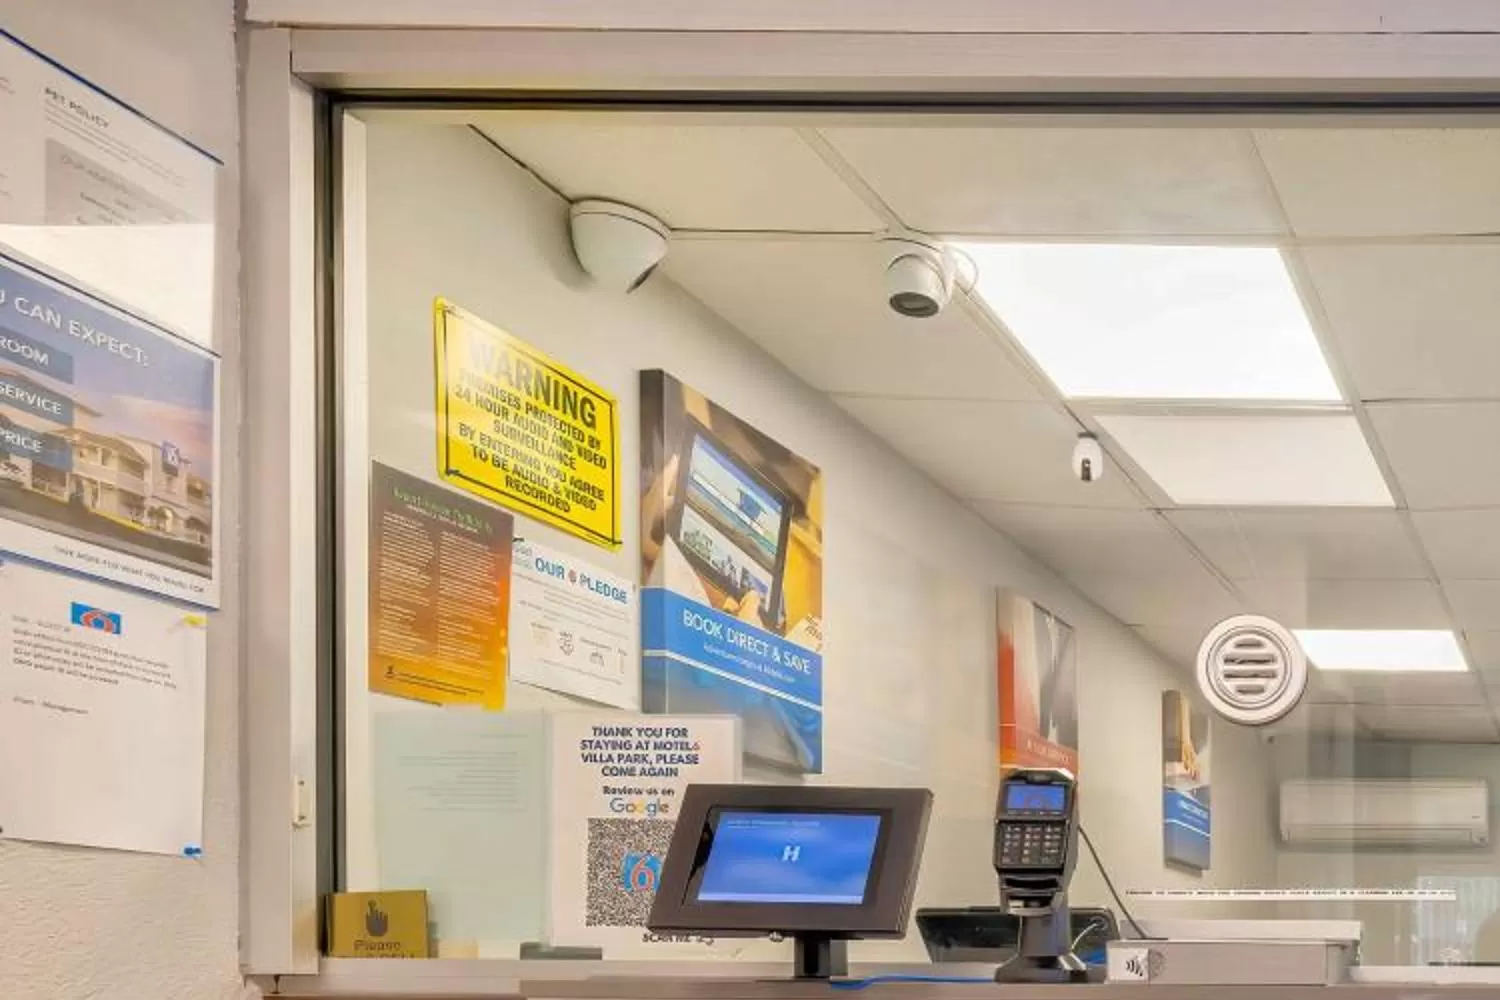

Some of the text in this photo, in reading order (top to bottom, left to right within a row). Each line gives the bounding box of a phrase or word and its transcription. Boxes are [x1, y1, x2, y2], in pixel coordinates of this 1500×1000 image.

[14, 297, 62, 329] CAN
[469, 340, 597, 430] WARNING
[475, 392, 509, 421] HOUR
[512, 412, 549, 441] AUDIO
[575, 443, 607, 470] VIDEO
[525, 402, 585, 443] PROTECTED
[458, 422, 605, 502] BY ENTERING YOU AGREE
[493, 419, 578, 471] SURVEILLANCE
[471, 443, 597, 511] TO BE AUDIO & VIDEO
[505, 474, 571, 513] RECORDED
[535, 557, 565, 582] OUR
[579, 572, 628, 605] PLEDGE
[683, 608, 724, 640] BOOK
[727, 627, 769, 657] DIRECT
[772, 646, 781, 666] &
[783, 651, 812, 676] SAVE
[580, 739, 632, 751] STAYING
[635, 740, 650, 751] AT
[592, 727, 688, 738] THANK YOU FOR
[581, 753, 699, 766] VILLA PARK, PLEASE
[601, 766, 679, 777] COME AGAIN
[602, 785, 675, 796] Review us on
[609, 797, 670, 817] Google
[631, 852, 654, 892] 6
